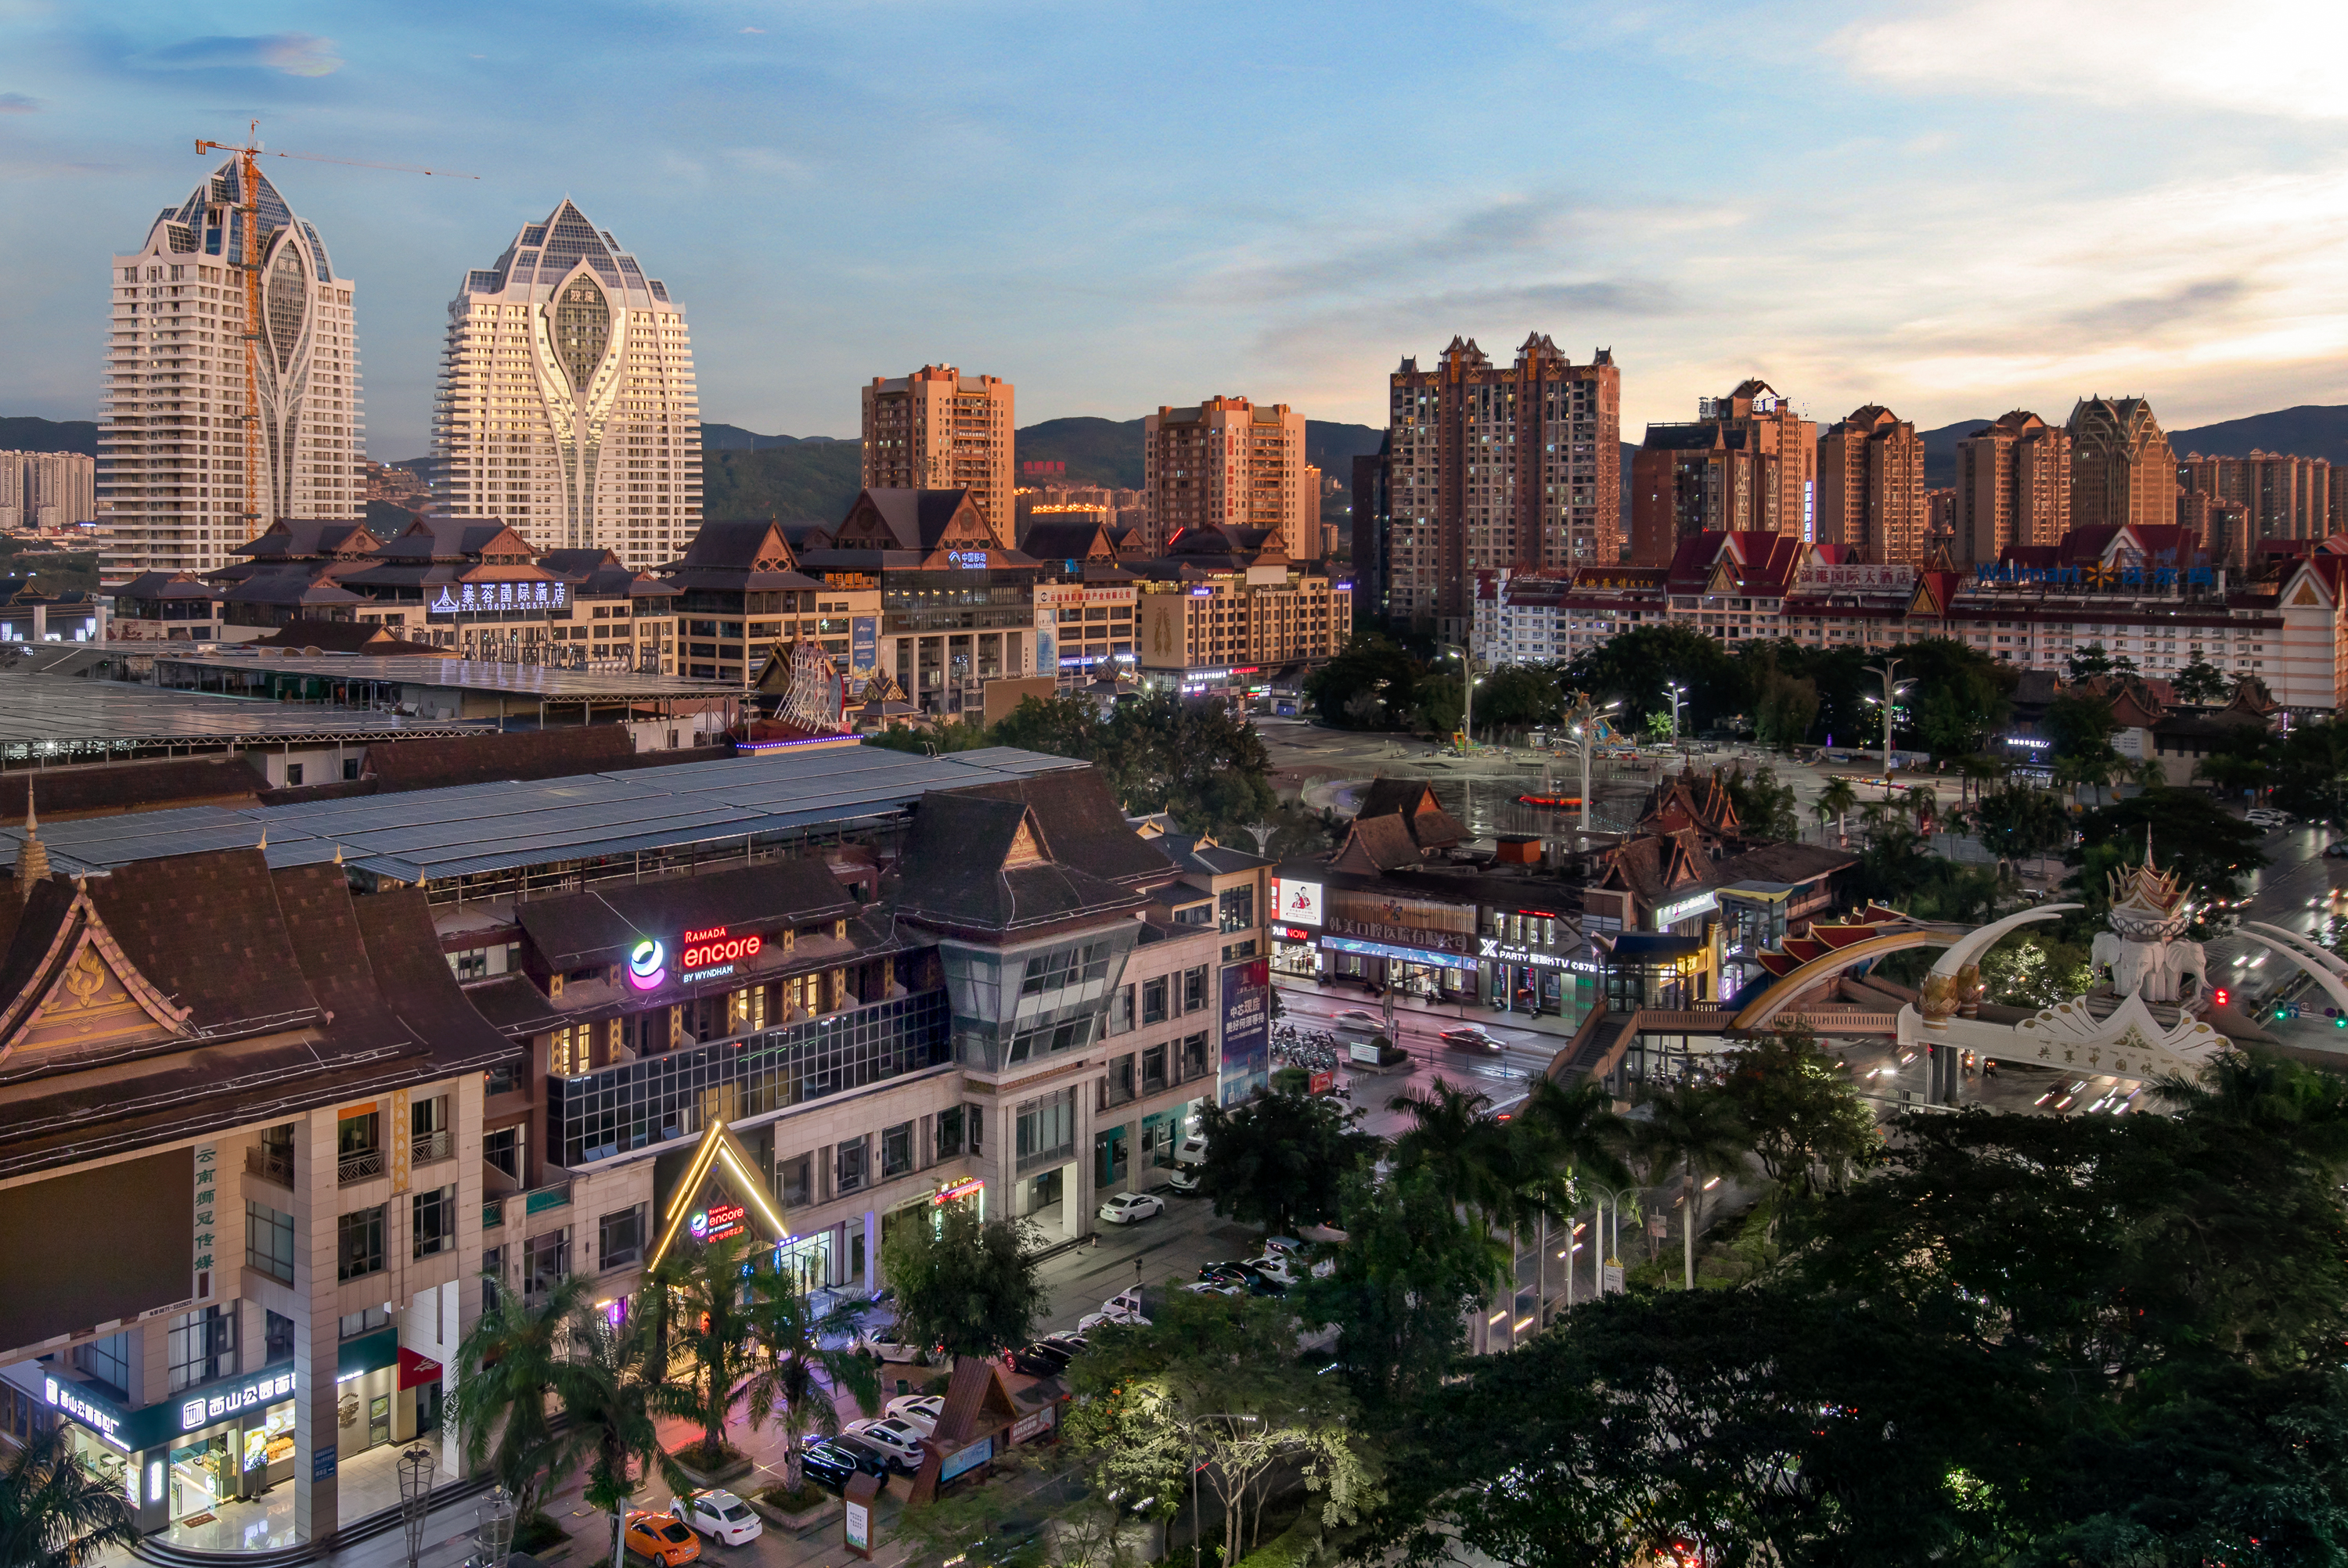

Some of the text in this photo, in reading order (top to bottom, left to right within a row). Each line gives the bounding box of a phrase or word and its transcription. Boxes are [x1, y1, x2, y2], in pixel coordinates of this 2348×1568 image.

[961, 552, 986, 563] 中国移动
[1975, 563, 2081, 583] Walmart
[2122, 566, 2213, 586] 沃尔玛
[463, 587, 565, 604] 泰谷国际酒店
[1329, 917, 1468, 951] 韩美口腔医院有限公司
[684, 936, 761, 968] encore
[1499, 951, 1529, 962] PARTY
[682, 965, 733, 984] BY WYNDHAM
[194, 1149, 217, 1271] 云南狮冠传媒
[708, 1207, 744, 1227] encore
